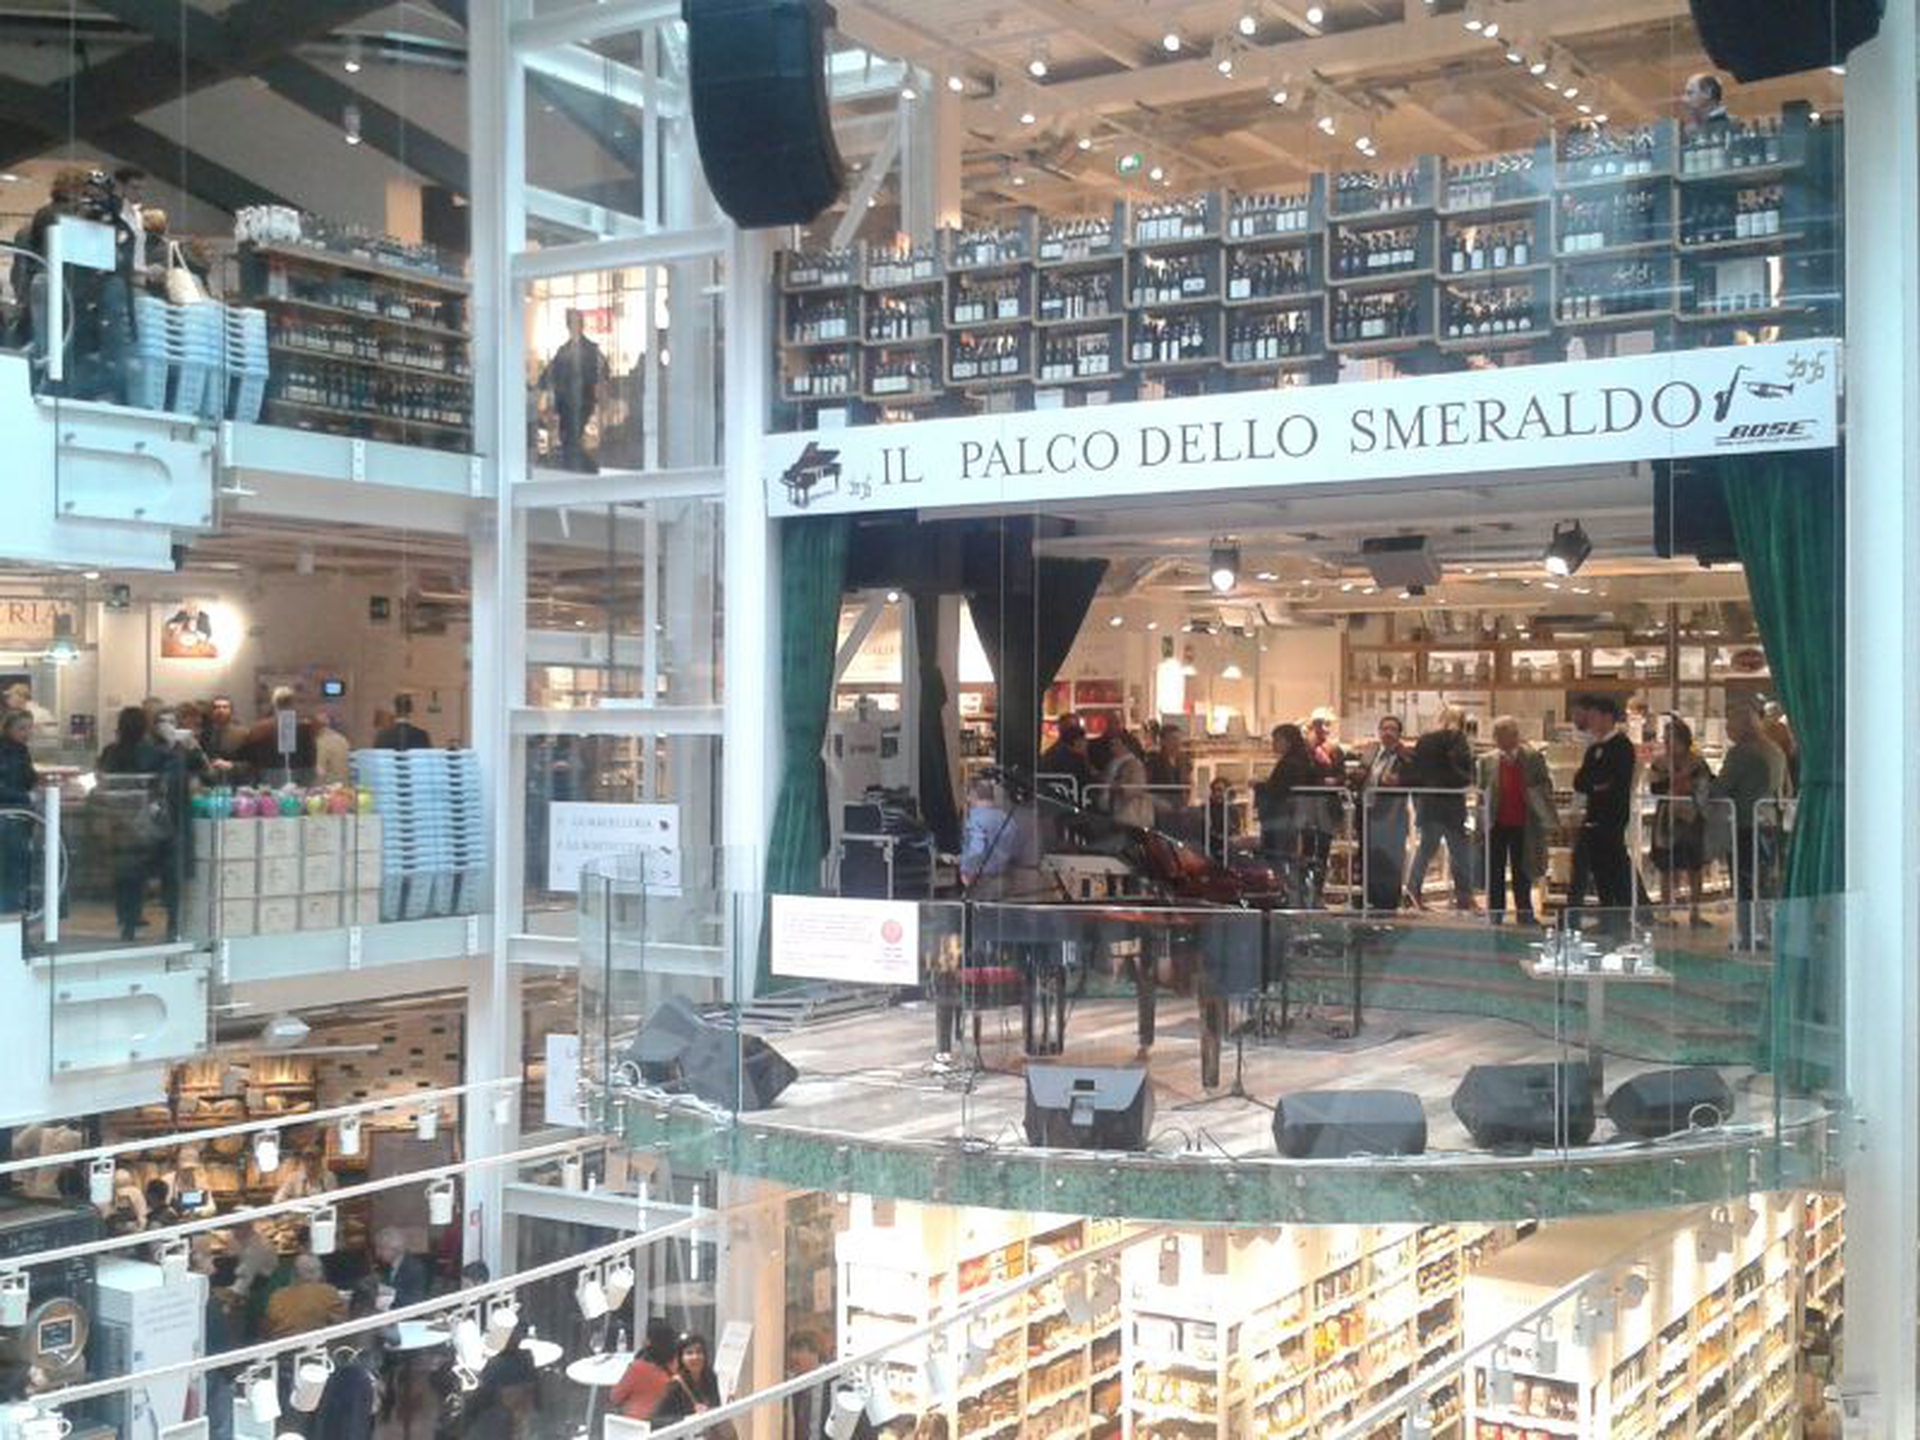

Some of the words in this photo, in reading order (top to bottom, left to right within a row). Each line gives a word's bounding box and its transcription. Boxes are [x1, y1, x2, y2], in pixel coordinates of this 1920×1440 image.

[881, 446, 923, 485] IL
[961, 430, 1120, 479] PALCO
[1139, 413, 1318, 468] DELLO
[1350, 381, 1702, 454] SMERALDO
[1724, 419, 1812, 440] BOSE
